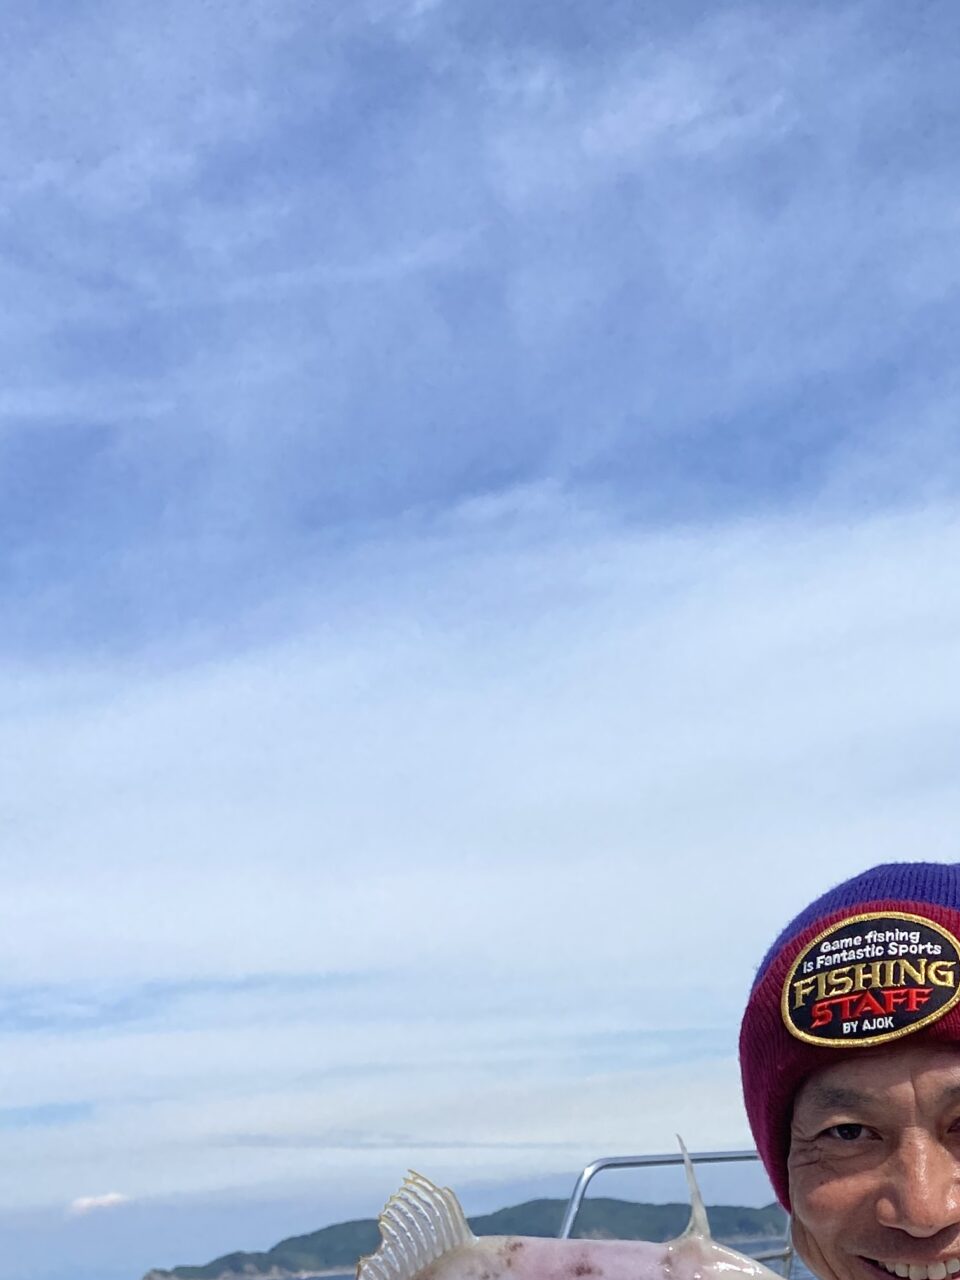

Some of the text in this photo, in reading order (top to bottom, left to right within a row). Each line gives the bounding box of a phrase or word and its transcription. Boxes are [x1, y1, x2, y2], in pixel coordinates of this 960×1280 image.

[820, 928, 920, 953] Game fishing
[816, 946, 884, 969] Fantastic
[888, 942, 942, 957] Sports
[793, 958, 957, 1010] FISHING
[810, 987, 934, 1029] STAFF
[843, 1016, 895, 1034] BY AJOK
